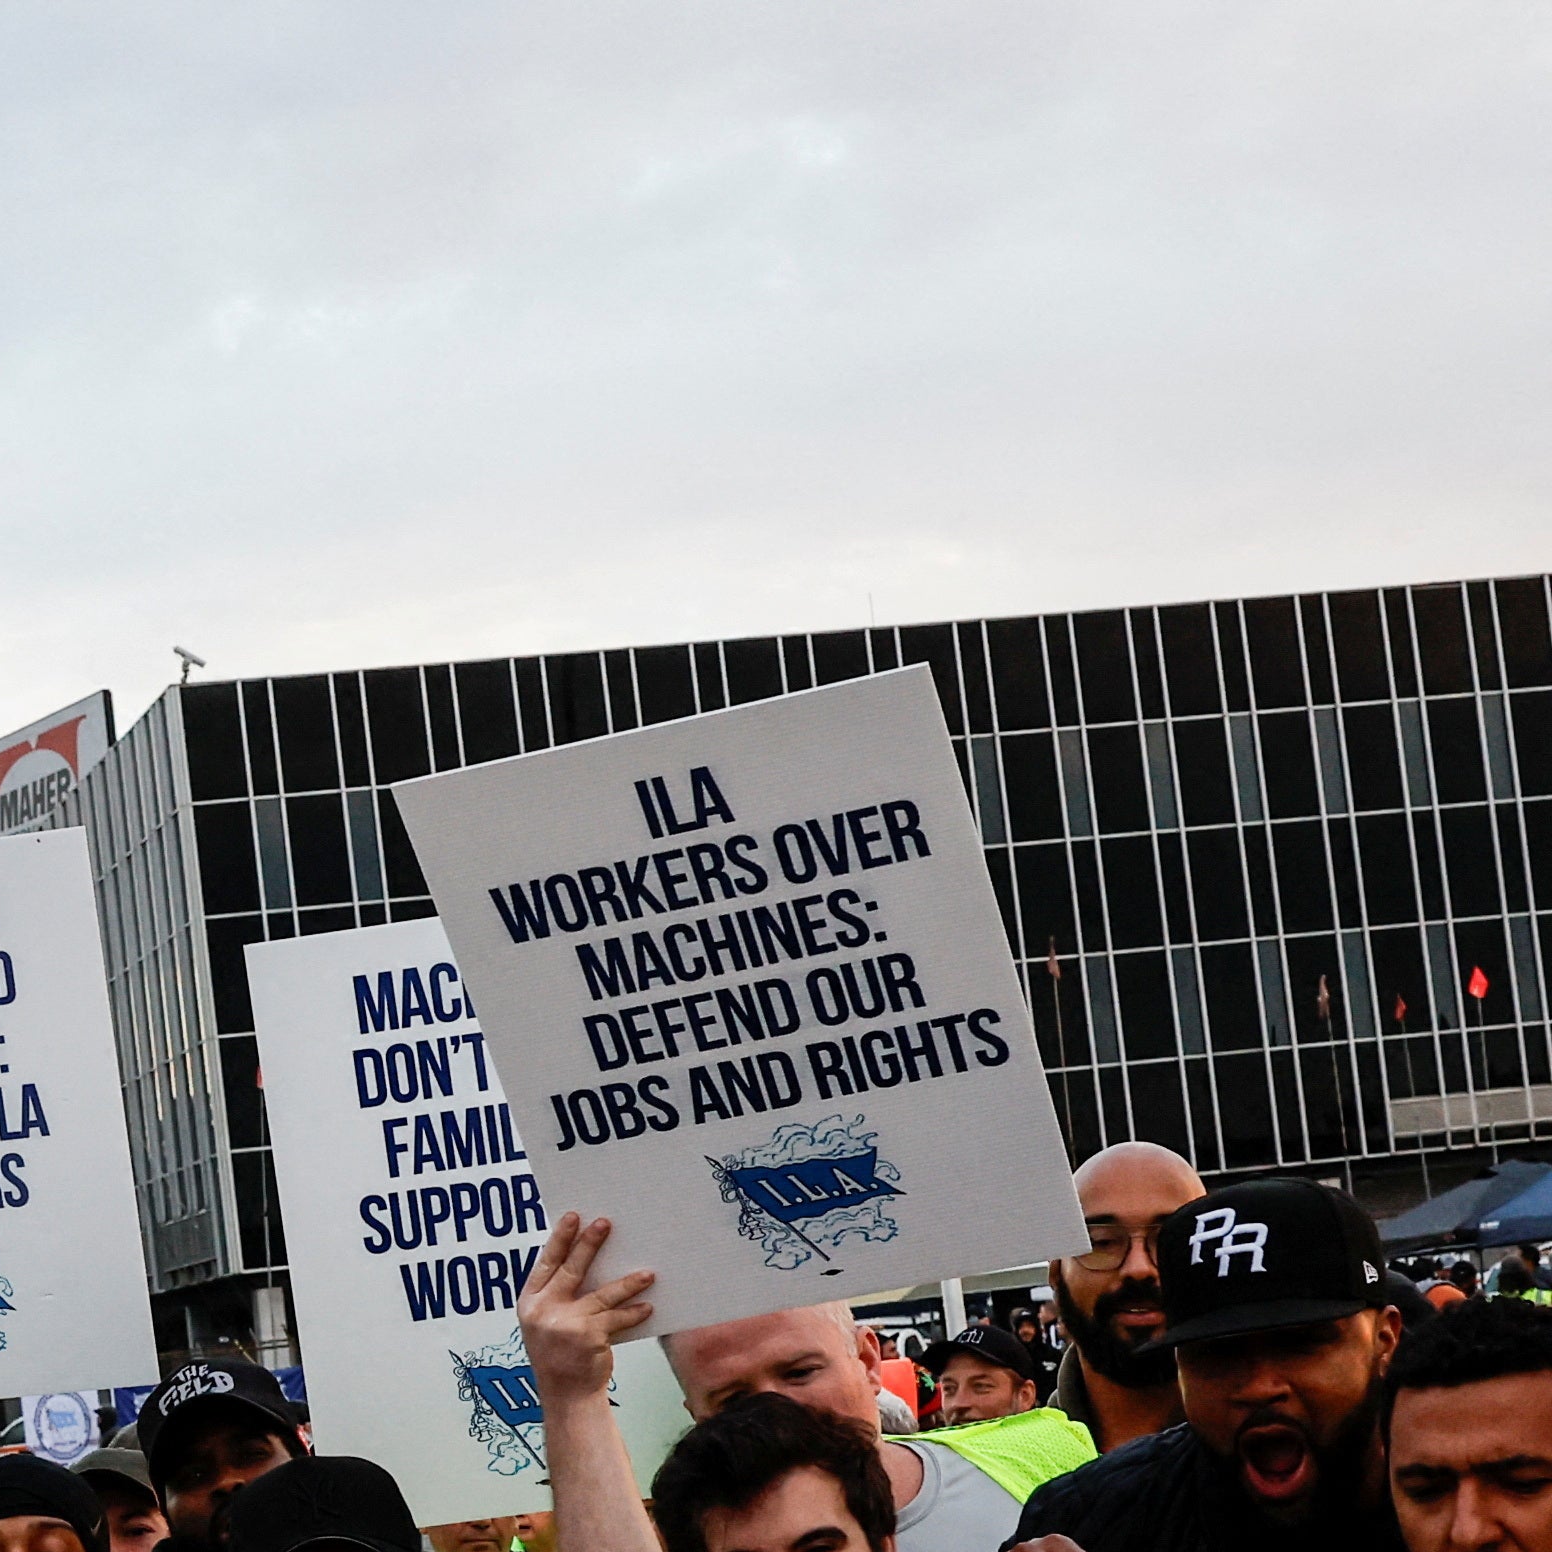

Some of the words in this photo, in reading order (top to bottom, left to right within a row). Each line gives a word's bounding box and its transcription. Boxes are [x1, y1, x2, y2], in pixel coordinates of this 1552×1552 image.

[0, 767, 71, 832] MAHER
[633, 766, 736, 839] ILA
[489, 836, 768, 945] WORKERS
[773, 800, 932, 884] OVER
[575, 888, 887, 1001] MACHINES:
[582, 978, 802, 1072] DEFEND
[806, 953, 927, 1026] OUR
[550, 1075, 680, 1151] JOBS
[688, 1051, 802, 1125] AND
[805, 1008, 1010, 1100] RIGHTS
[382, 1103, 527, 1178] FAMIL
[360, 1174, 547, 1254] SUPPOR
[400, 1246, 540, 1321] WORK
